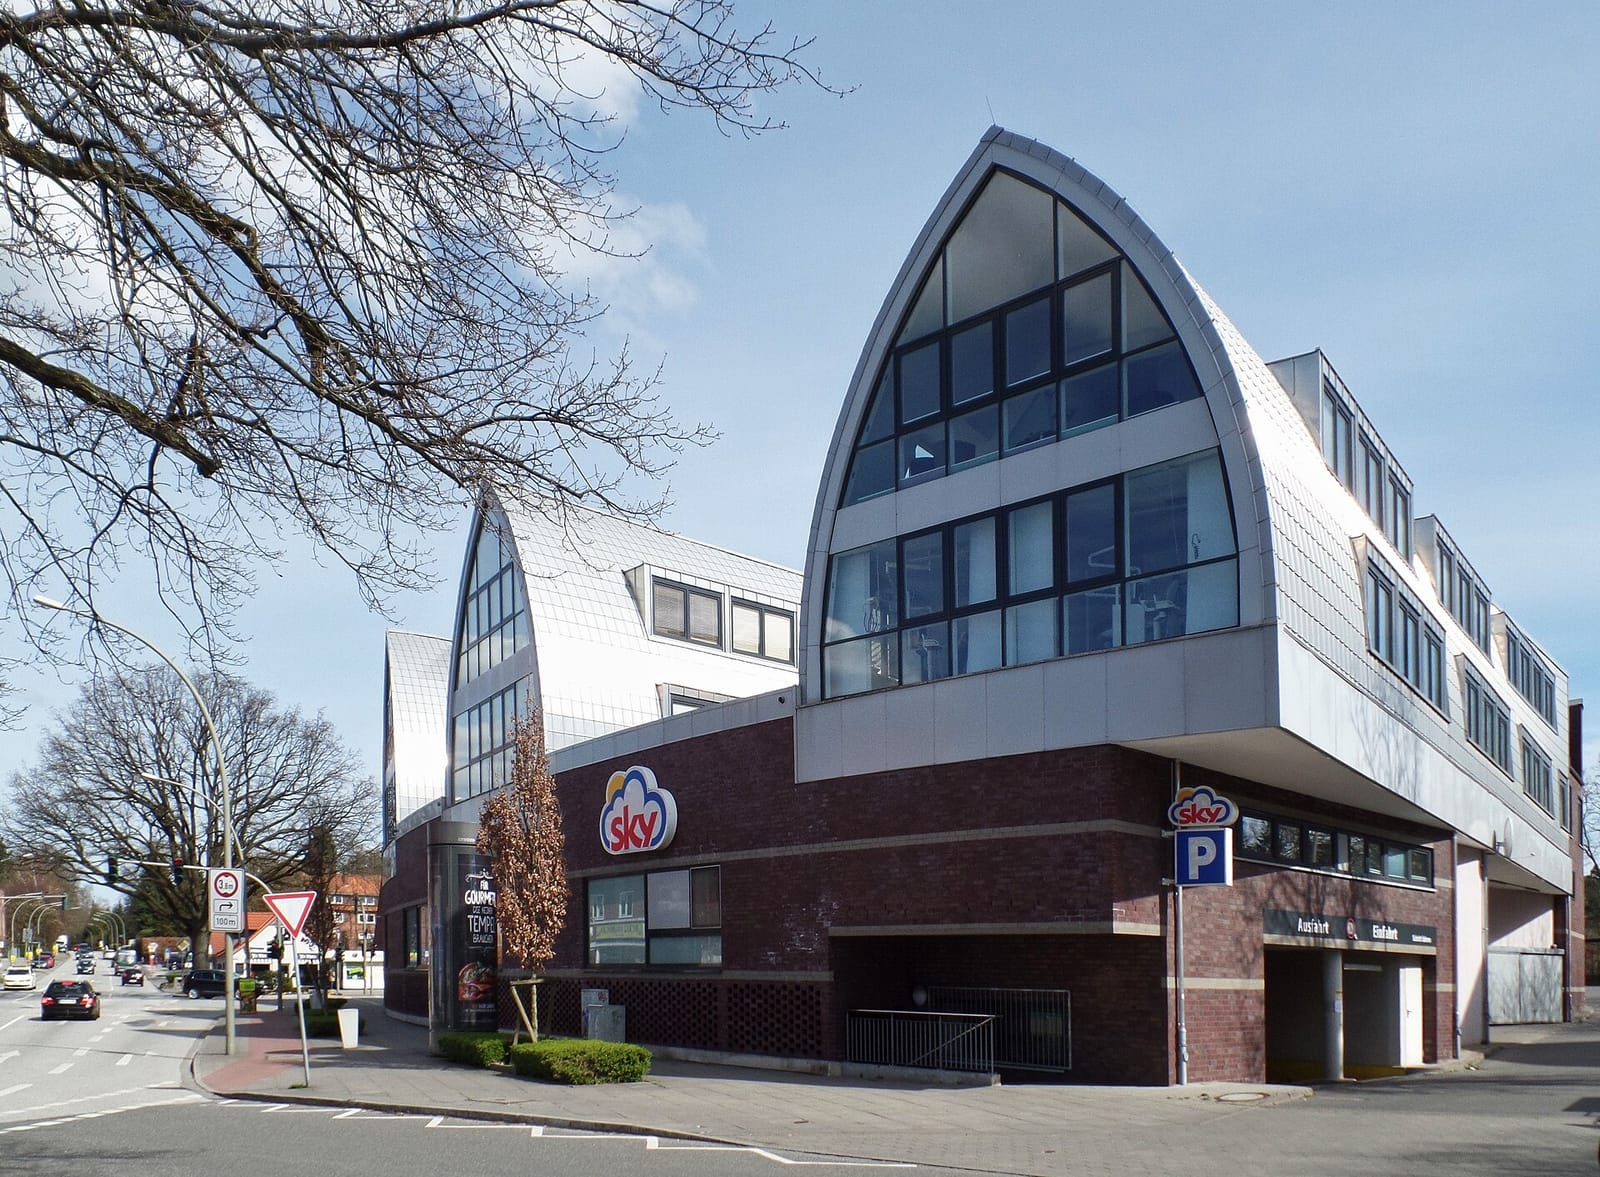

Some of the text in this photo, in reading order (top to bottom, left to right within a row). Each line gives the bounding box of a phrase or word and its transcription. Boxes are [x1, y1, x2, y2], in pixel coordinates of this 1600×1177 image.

[1179, 803, 1223, 825] sky
[611, 805, 657, 851] sky
[1187, 836, 1217, 880] P
[1297, 917, 1329, 934] Ausfahrt
[1372, 924, 1398, 940] Einfahrt
